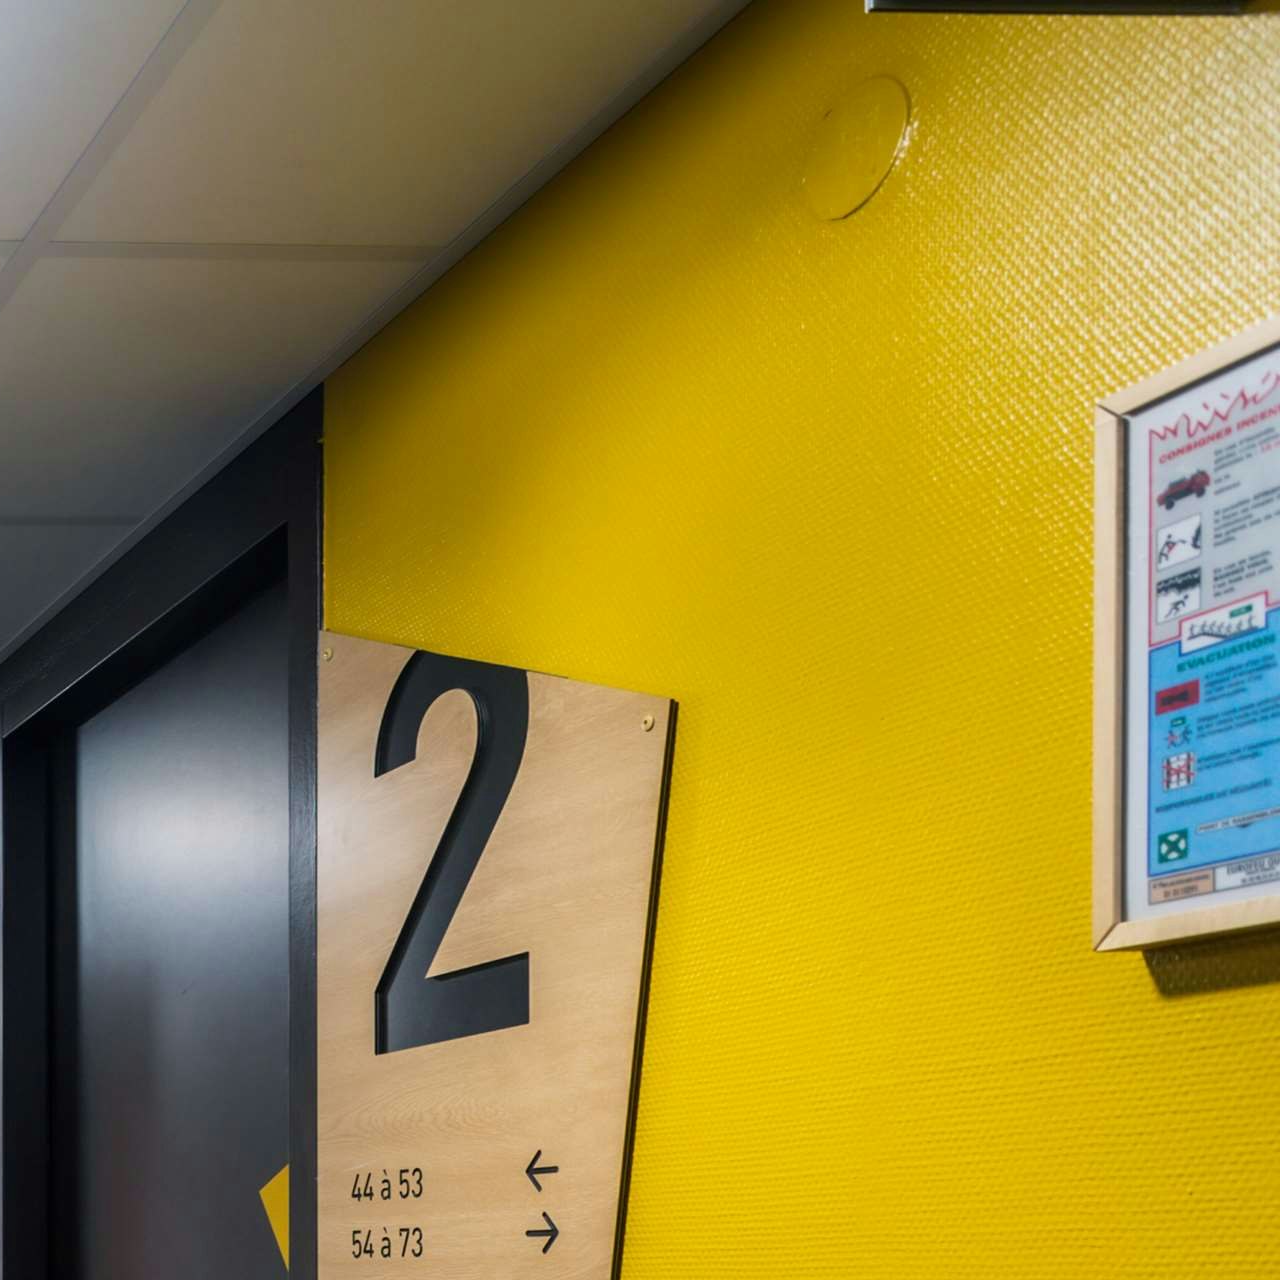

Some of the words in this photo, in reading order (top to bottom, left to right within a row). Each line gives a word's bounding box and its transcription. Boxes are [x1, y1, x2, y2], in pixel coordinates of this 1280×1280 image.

[374, 649, 530, 1055] 2
[351, 1172, 375, 1202] 44
[380, 1169, 392, 1201] à
[399, 1167, 423, 1199] 53
[351, 1229, 375, 1259] 54
[380, 1227, 392, 1258] à
[399, 1227, 424, 1258] 73
